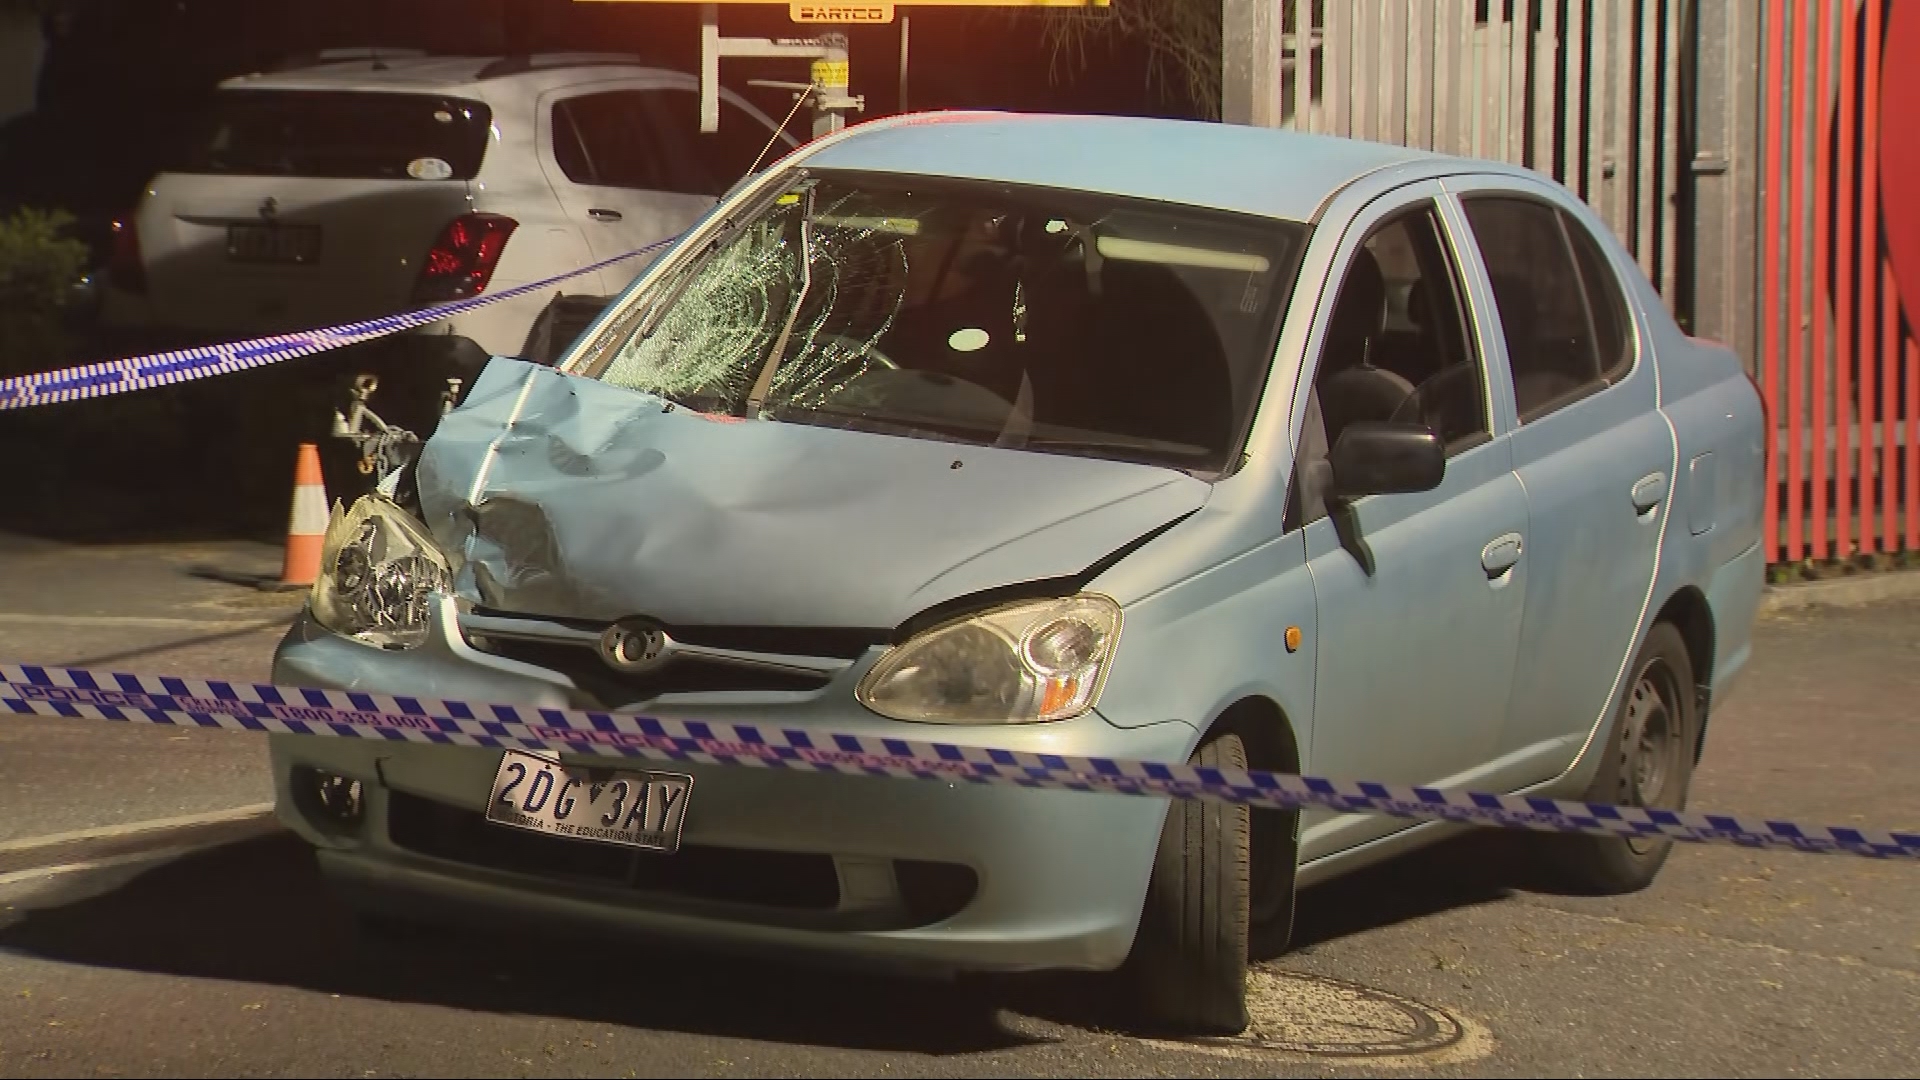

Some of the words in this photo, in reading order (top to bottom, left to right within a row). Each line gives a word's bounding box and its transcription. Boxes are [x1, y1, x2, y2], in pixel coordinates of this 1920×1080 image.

[800, 7, 883, 20] BARTCO
[20, 685, 150, 708] POLICE
[276, 705, 334, 722] 1800
[338, 710, 383, 727] 333
[387, 714, 431, 731] 000
[498, 762, 583, 820] 2DG
[601, 780, 684, 832] 3AY
[555, 822, 575, 834] THE
[576, 825, 633, 842] EDUCATION
